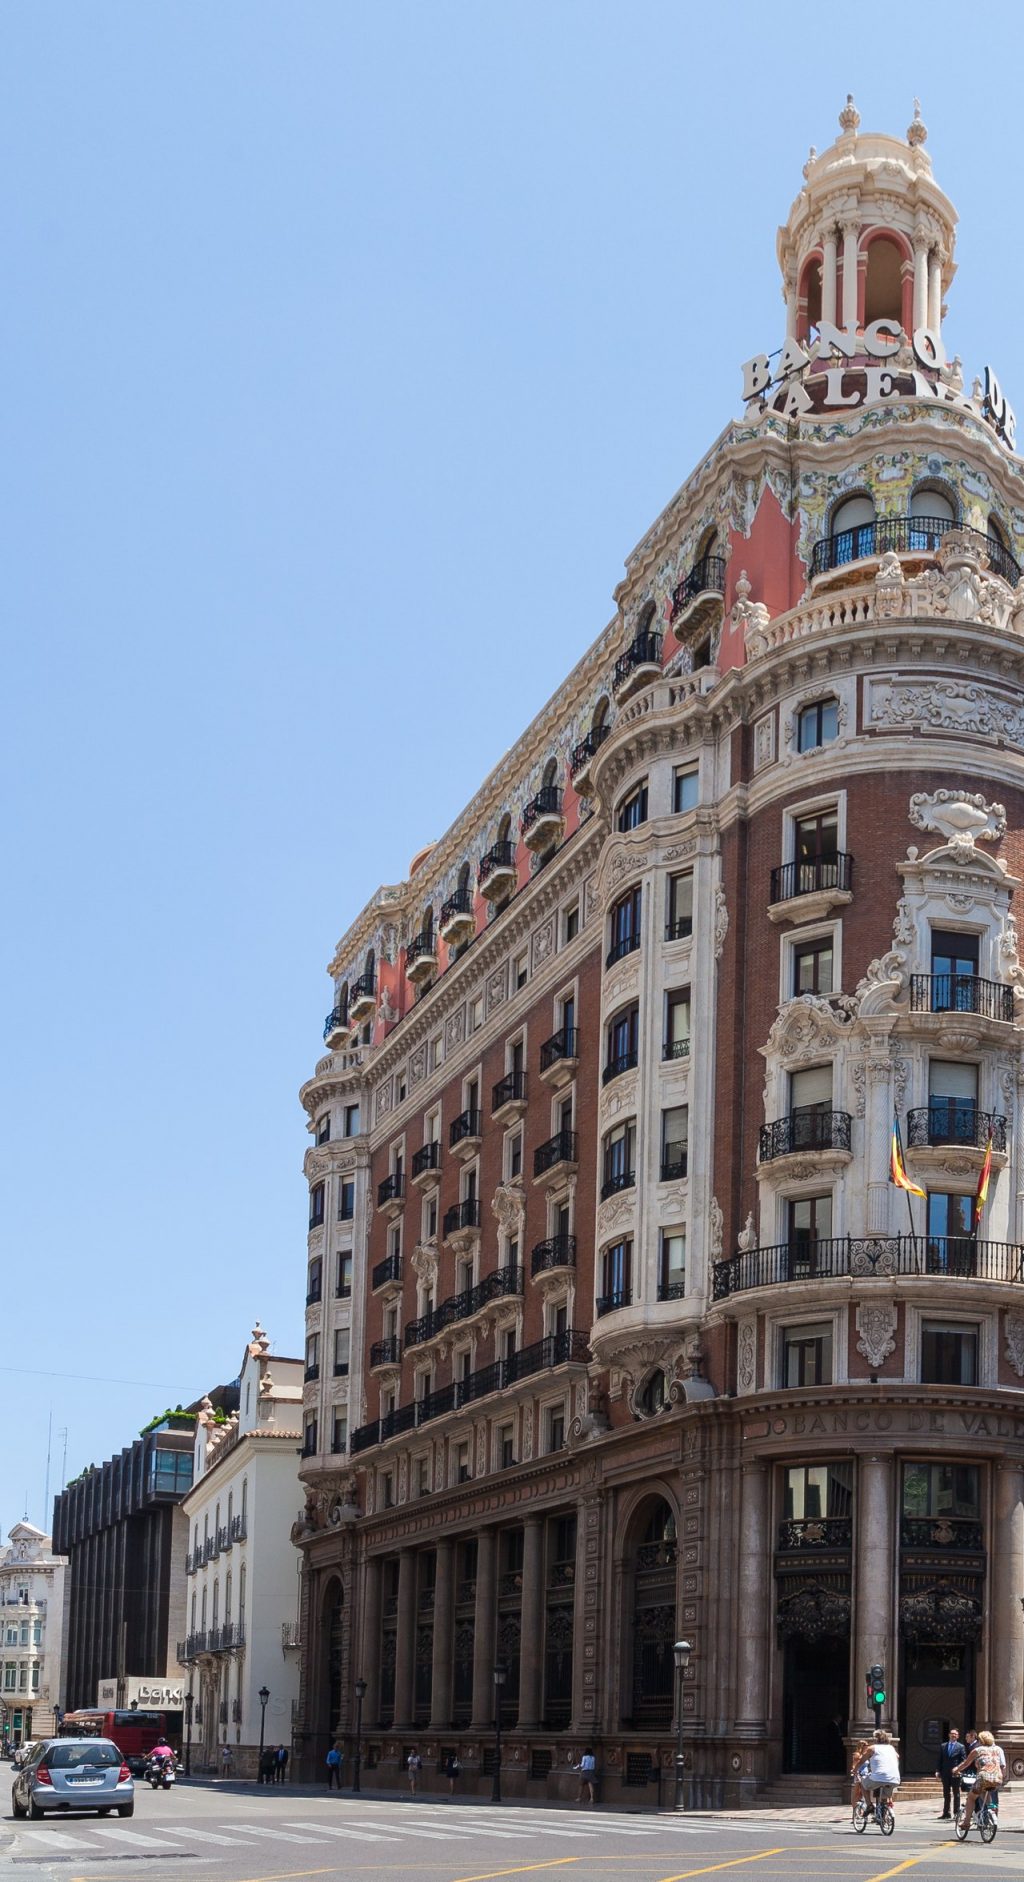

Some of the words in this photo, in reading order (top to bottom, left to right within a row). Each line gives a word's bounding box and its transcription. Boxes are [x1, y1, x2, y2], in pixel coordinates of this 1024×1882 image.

[741, 319, 946, 401] BANCO
[791, 1409, 893, 1435] BANCO
[907, 1411, 946, 1433] DE
